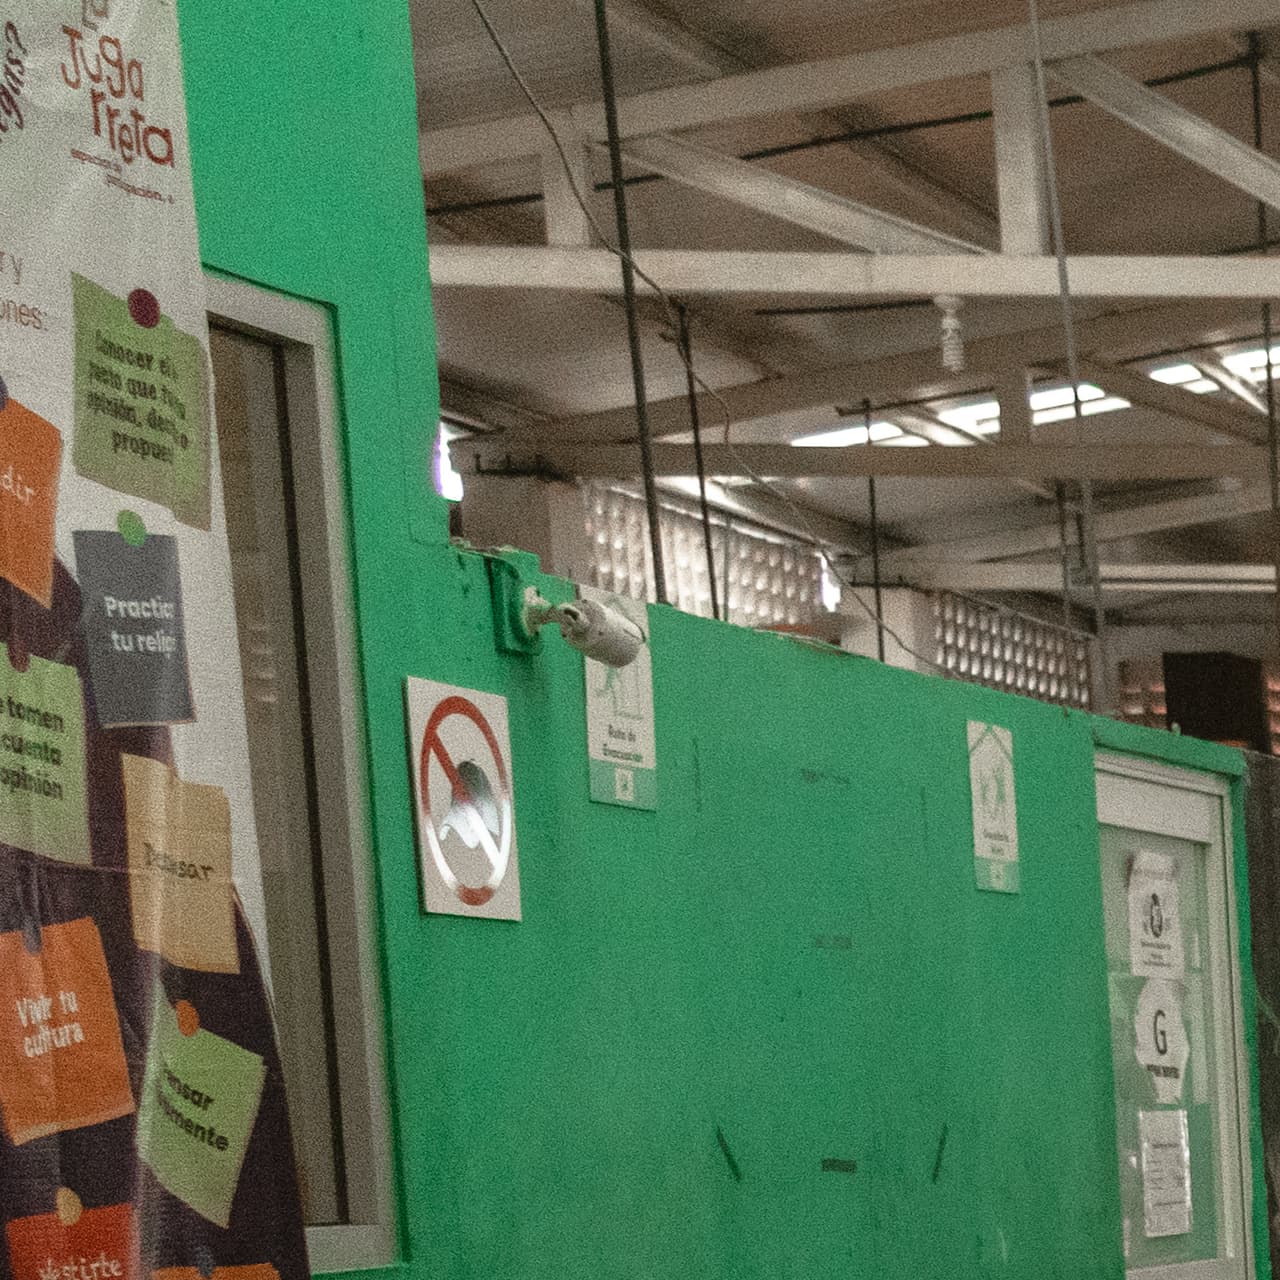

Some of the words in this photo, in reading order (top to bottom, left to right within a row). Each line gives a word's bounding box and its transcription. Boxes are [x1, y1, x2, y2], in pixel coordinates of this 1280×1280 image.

[111, 630, 134, 652] tu
[7, 696, 64, 731] tomen
[1152, 1008, 1169, 1056] G
